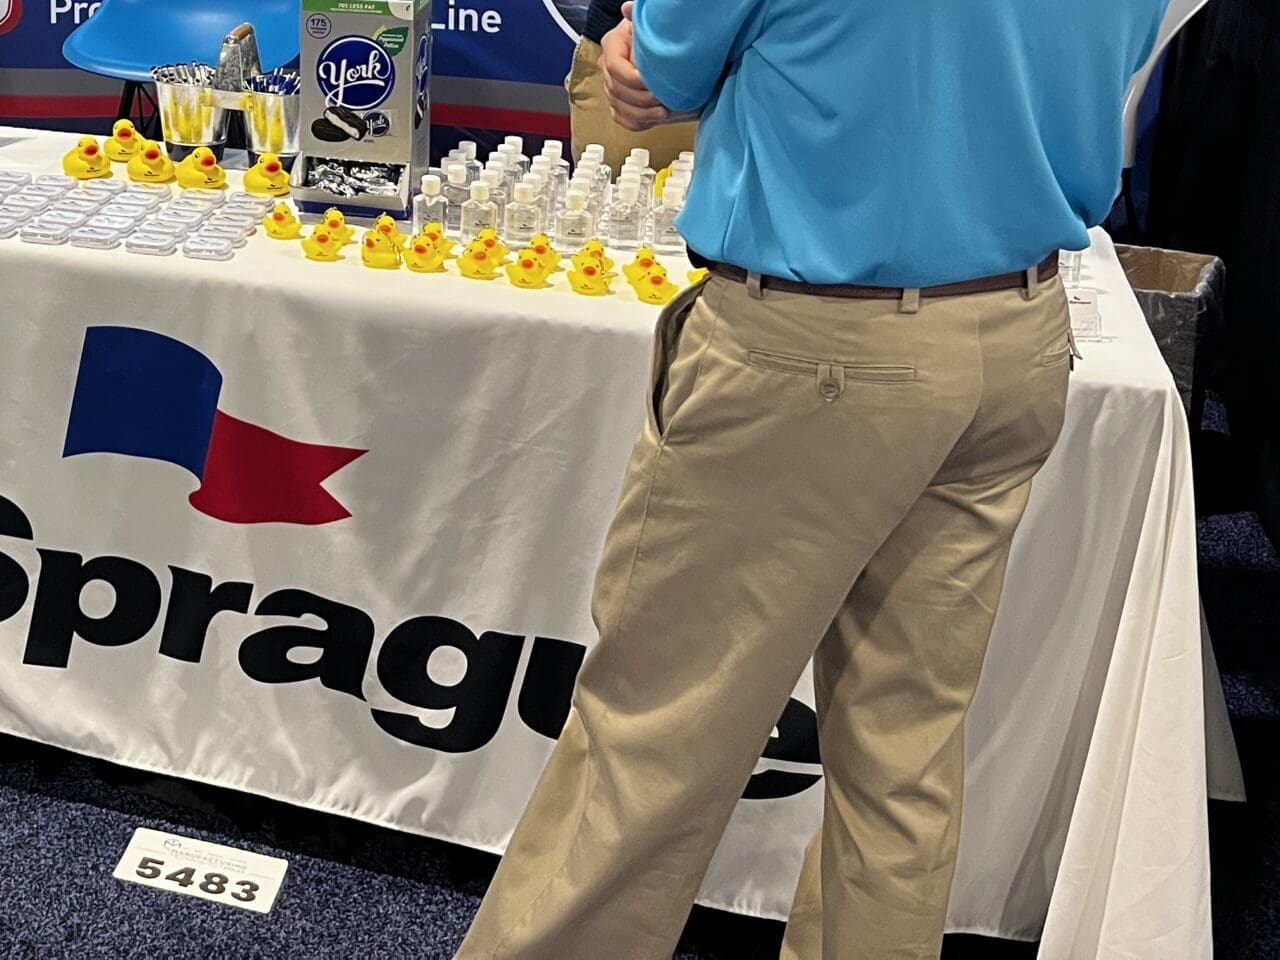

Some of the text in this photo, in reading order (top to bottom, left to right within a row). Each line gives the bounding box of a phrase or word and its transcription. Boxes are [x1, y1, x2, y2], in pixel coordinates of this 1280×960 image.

[310, 18, 327, 27] 175
[318, 50, 387, 108] York
[135, 856, 261, 902] 5483
